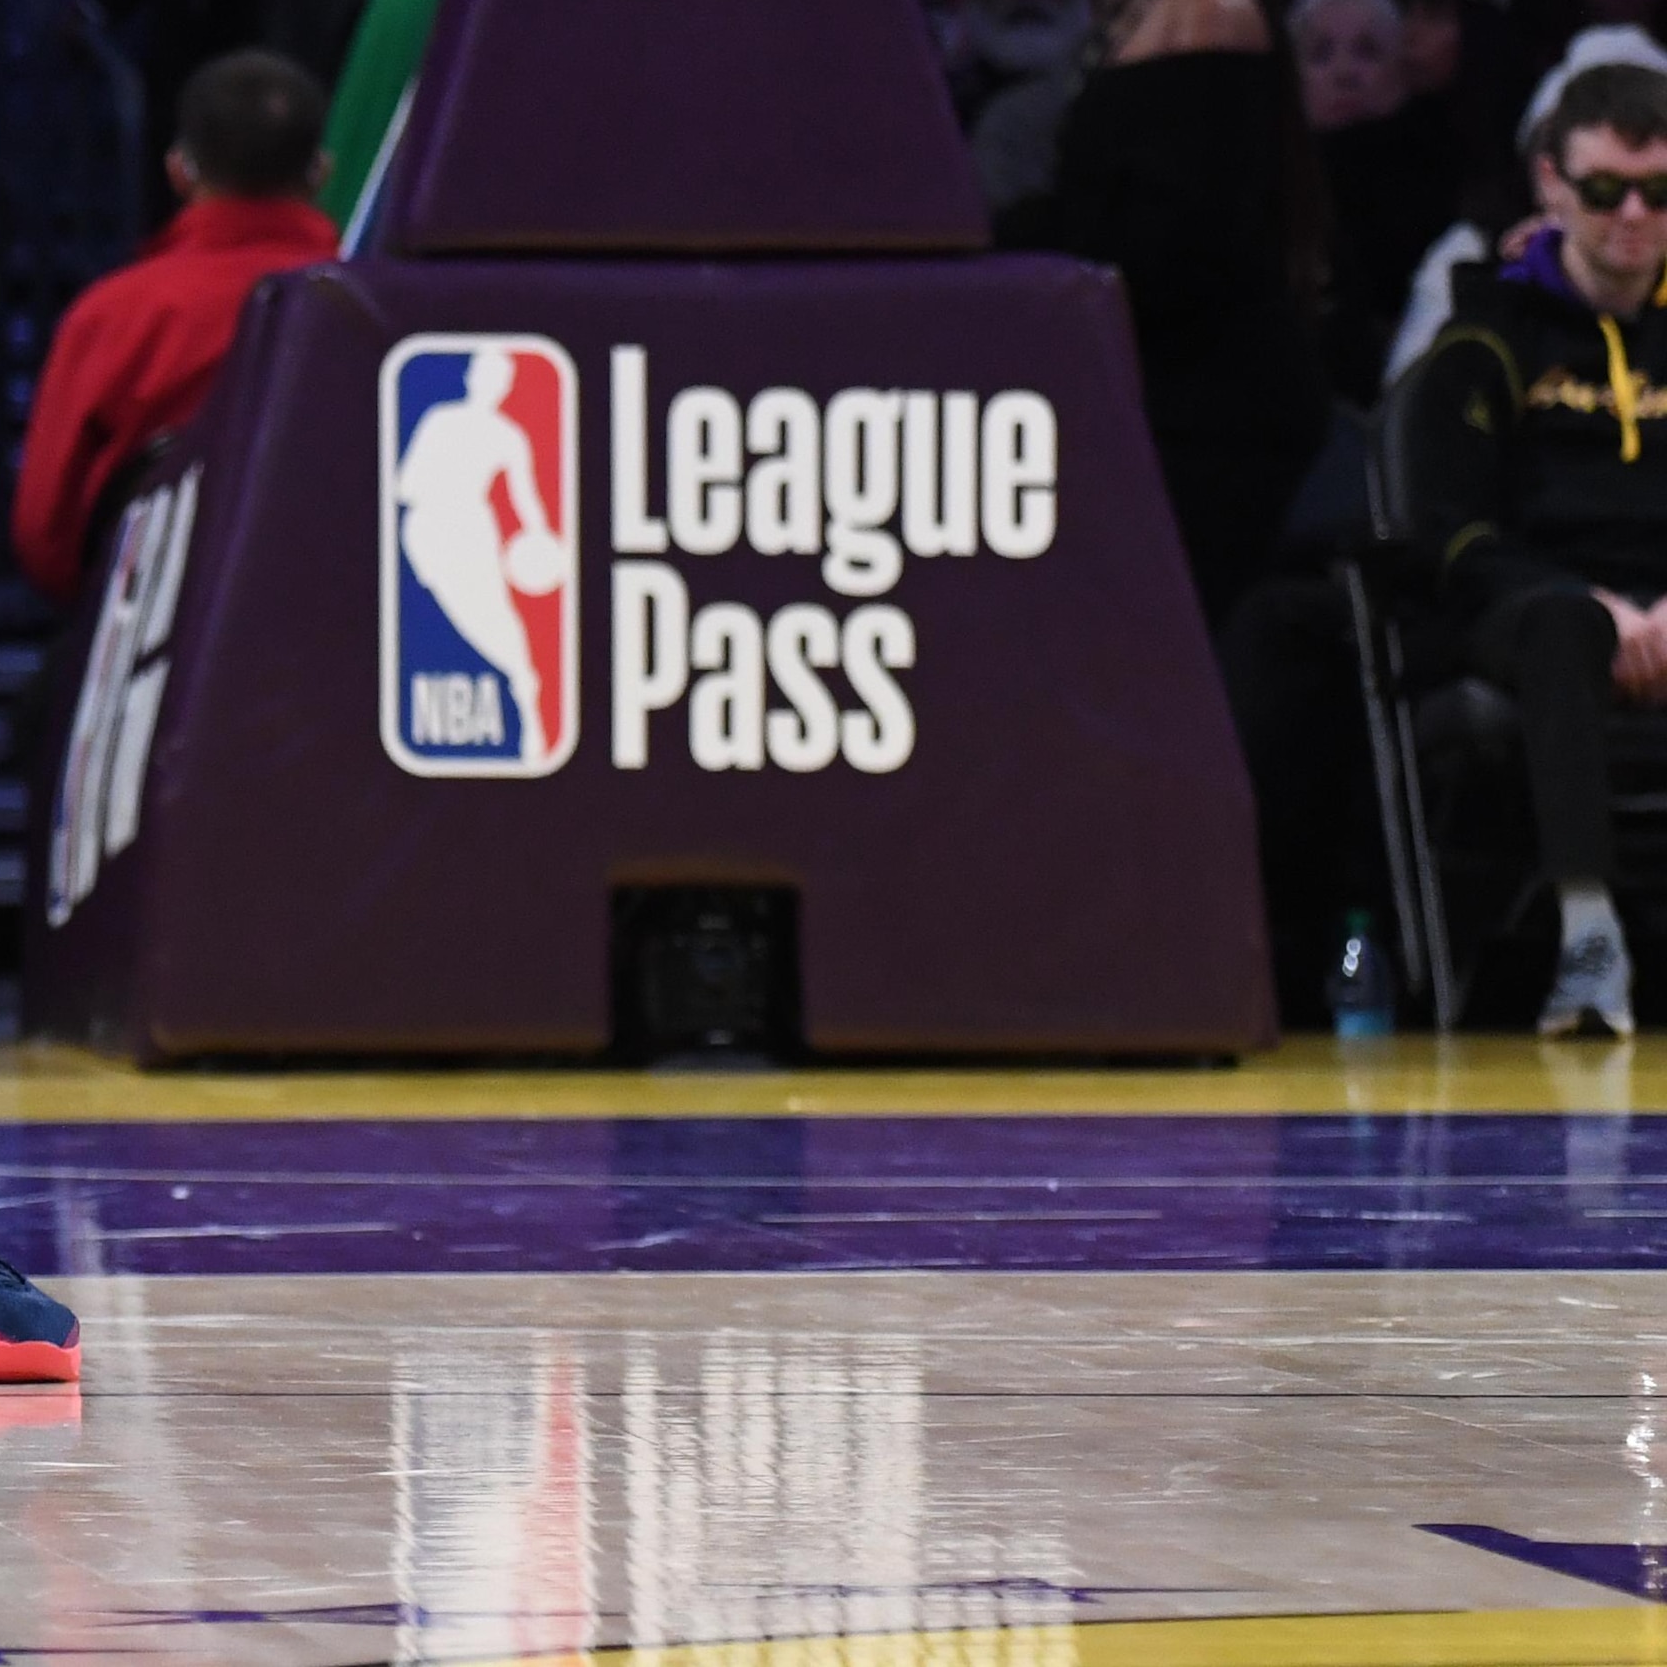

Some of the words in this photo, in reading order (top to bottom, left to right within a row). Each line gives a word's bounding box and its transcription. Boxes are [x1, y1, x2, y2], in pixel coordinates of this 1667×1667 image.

[611, 344, 1059, 596] League
[411, 672, 505, 746] NBA
[611, 562, 917, 772] Pass
